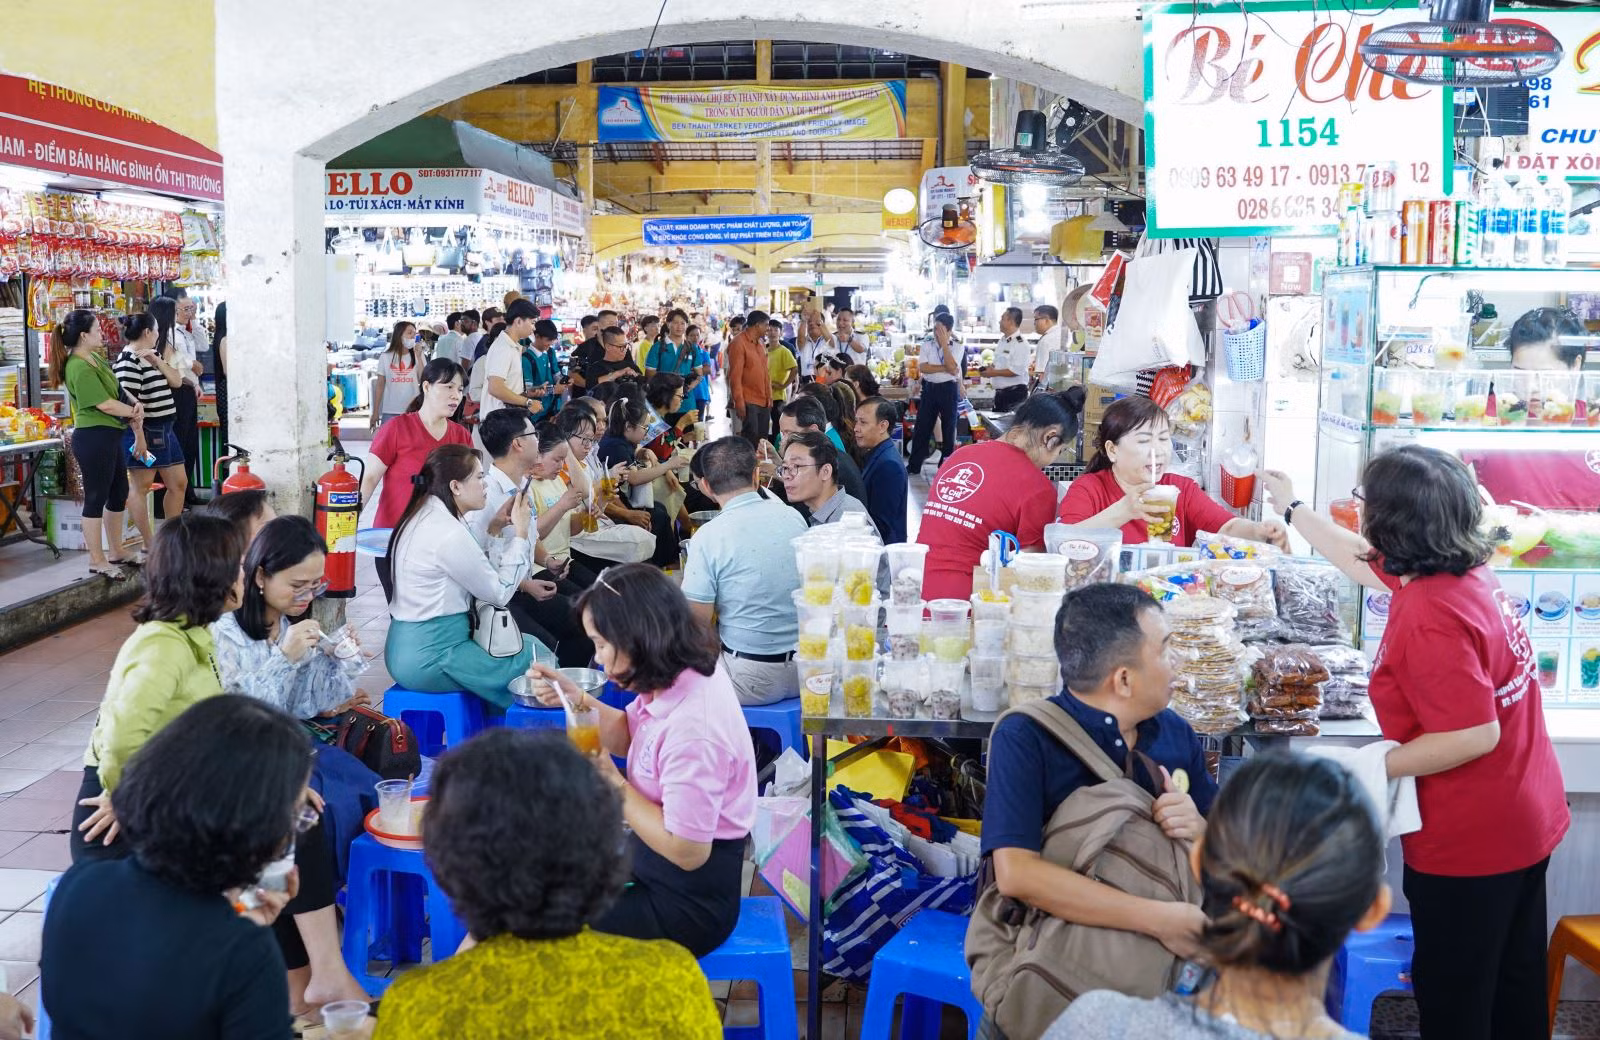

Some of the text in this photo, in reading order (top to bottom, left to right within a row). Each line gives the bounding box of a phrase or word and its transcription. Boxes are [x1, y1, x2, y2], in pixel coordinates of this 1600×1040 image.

[705, 105, 728, 117] TRONG
[671, 122, 687, 130] BEN
[688, 122, 711, 130] THANH
[713, 122, 742, 130] MARKET
[744, 121, 777, 130] VENDORS
[808, 119, 844, 127] FRIENDLY
[844, 117, 867, 126] IMAGE
[791, 128, 806, 136] AND
[808, 127, 843, 136] TOURISTS
[1256, 116, 1340, 148] 1154
[1540, 128, 1600, 144] CHU
[35, 140, 67, 165] ĐIỂM
[69, 149, 94, 170] BÁN
[95, 154, 127, 177] HÀNG
[129, 160, 153, 182] BÌNH
[154, 162, 169, 185] ỔN
[170, 170, 186, 192] THỊ
[186, 173, 222, 195] TRƯỜNG
[1410, 162, 1430, 183] 12
[1518, 153, 1560, 174] ĐẶT
[325, 171, 413, 196] ELLO
[1216, 166, 1237, 188] 63
[1242, 165, 1263, 187] 49
[1270, 165, 1290, 187] 17
[1309, 163, 1350, 186] 0913
[507, 179, 535, 208] HELLO
[434, 197, 464, 210] KÍNH
[711, 222, 726, 231] THỰC
[727, 220, 743, 229] PHẨM
[743, 219, 759, 229] CHẤT
[739, 230, 755, 239] PHÁT
